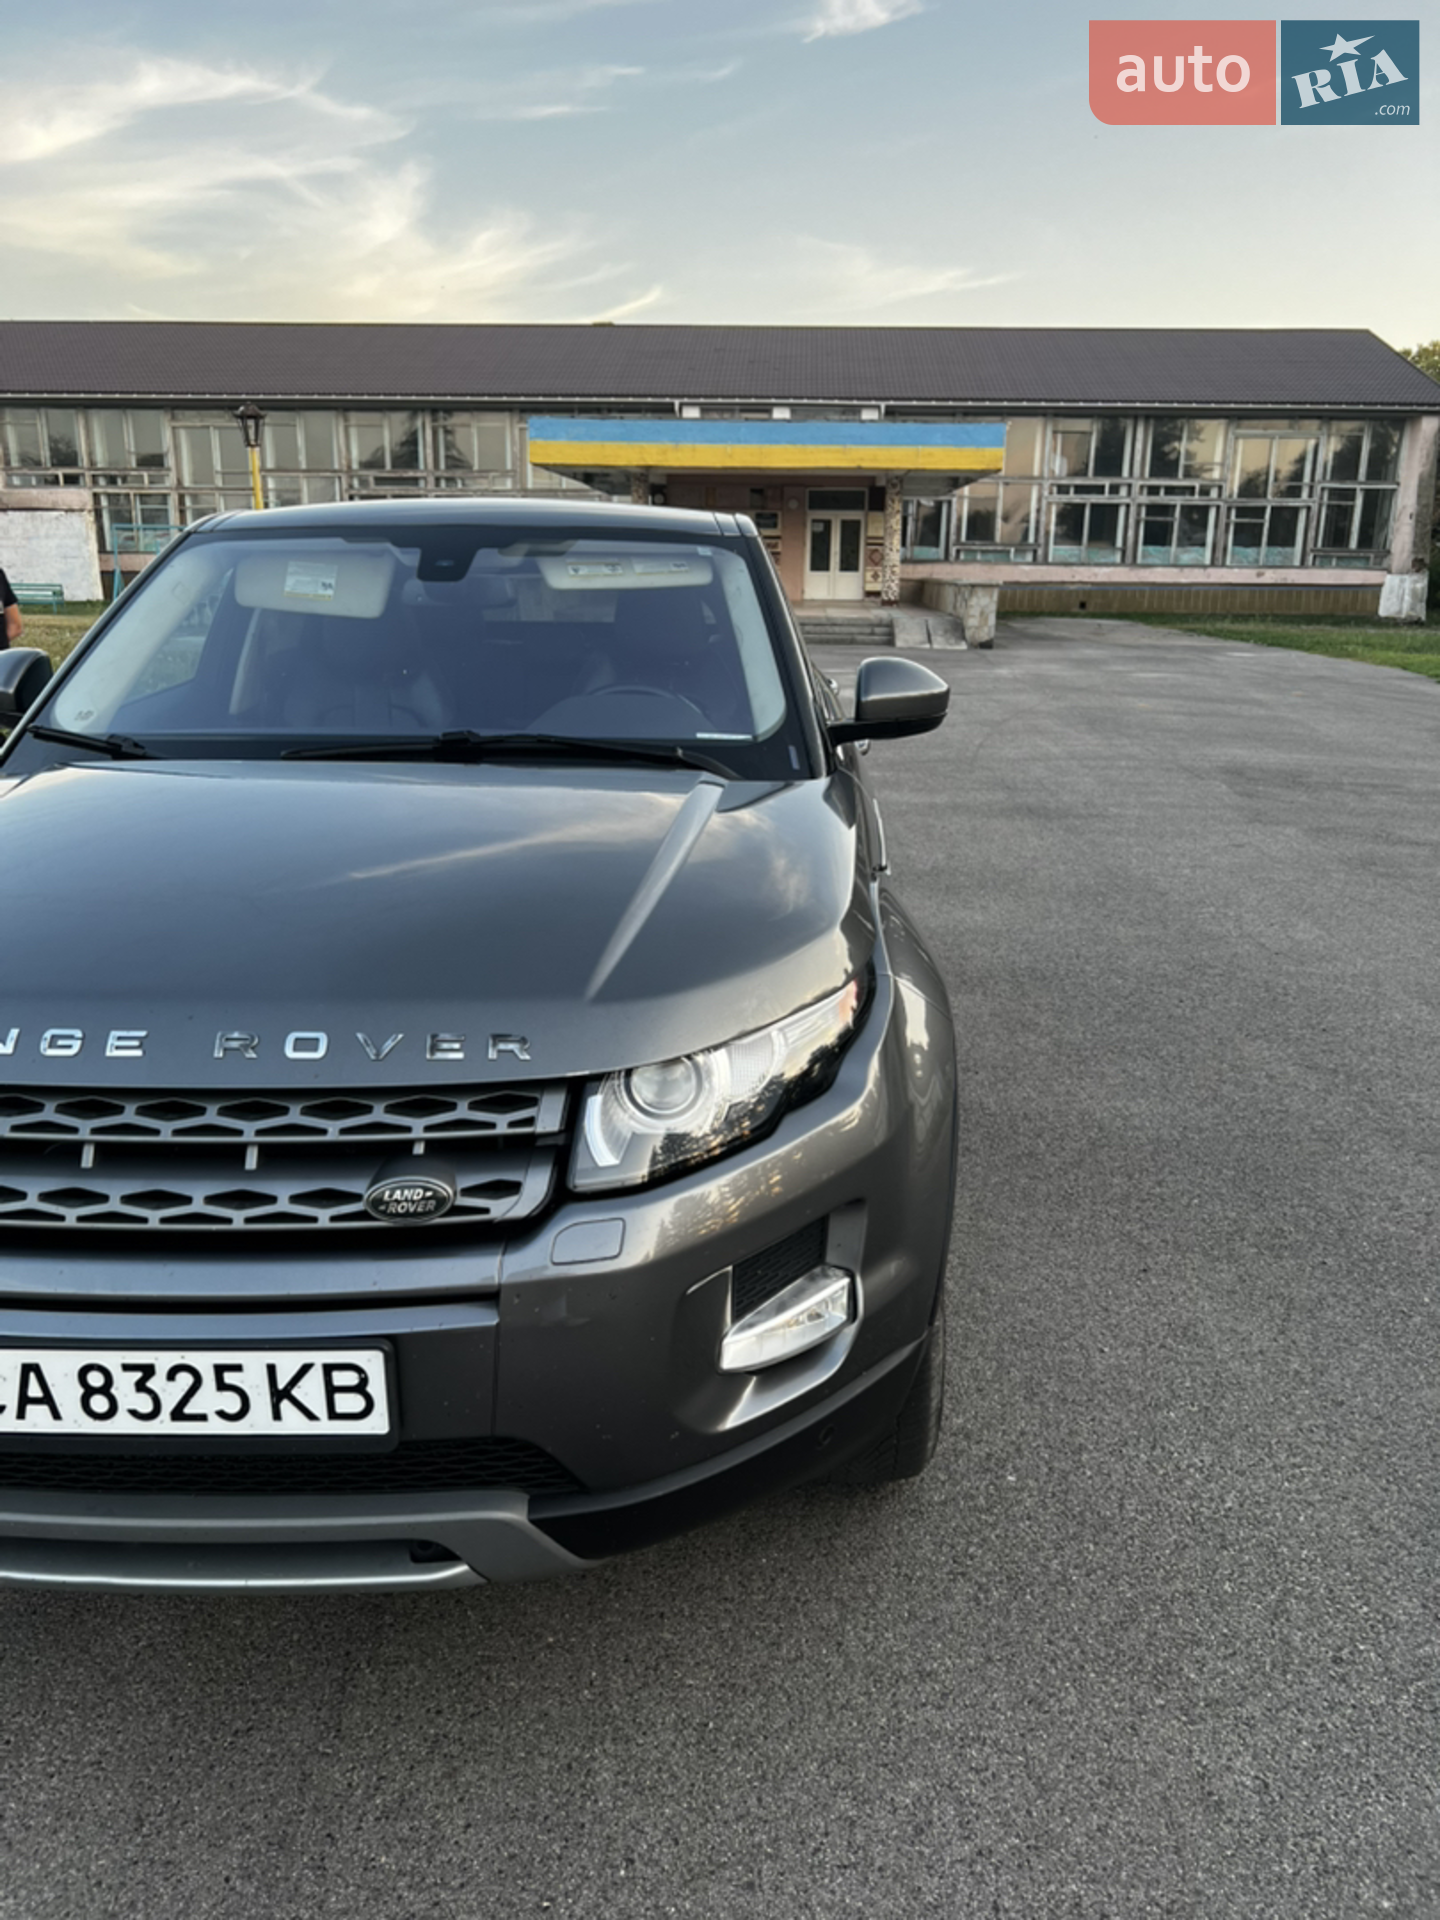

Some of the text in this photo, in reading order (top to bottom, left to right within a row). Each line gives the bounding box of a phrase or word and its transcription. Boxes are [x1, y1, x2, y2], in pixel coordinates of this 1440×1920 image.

[212, 1031, 532, 1062] ROVER
[383, 1188, 424, 1202] LAND
[387, 1200, 437, 1214] ROVER
[0, 1362, 375, 1422] A 8325 KB
